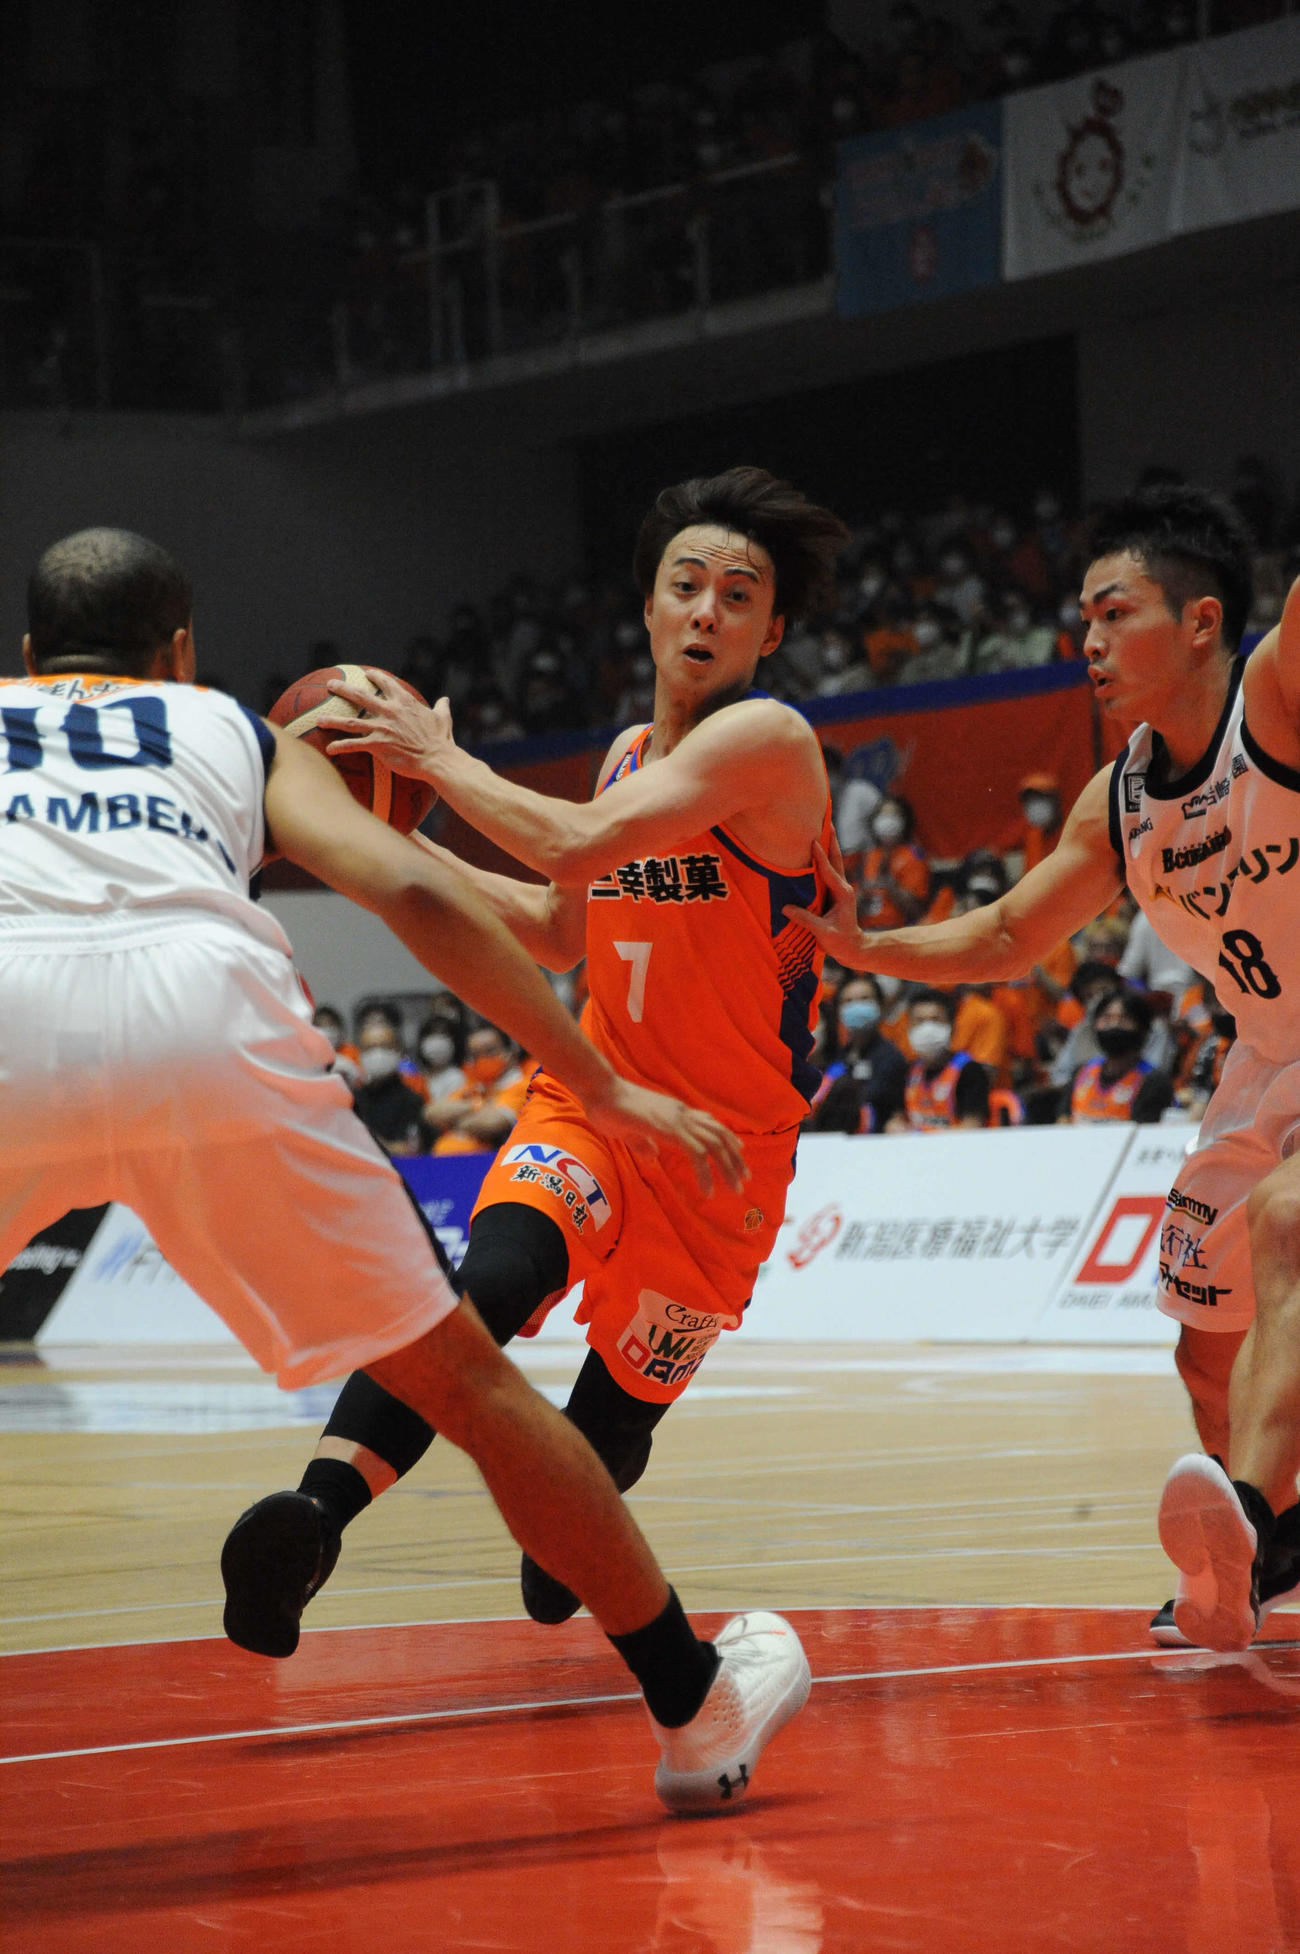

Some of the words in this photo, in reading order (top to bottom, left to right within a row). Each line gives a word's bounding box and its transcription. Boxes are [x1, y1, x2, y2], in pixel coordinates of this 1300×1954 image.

[613, 940, 654, 1024] 7
[1218, 929, 1283, 1000] 18
[513, 1144, 608, 1207] NCT
